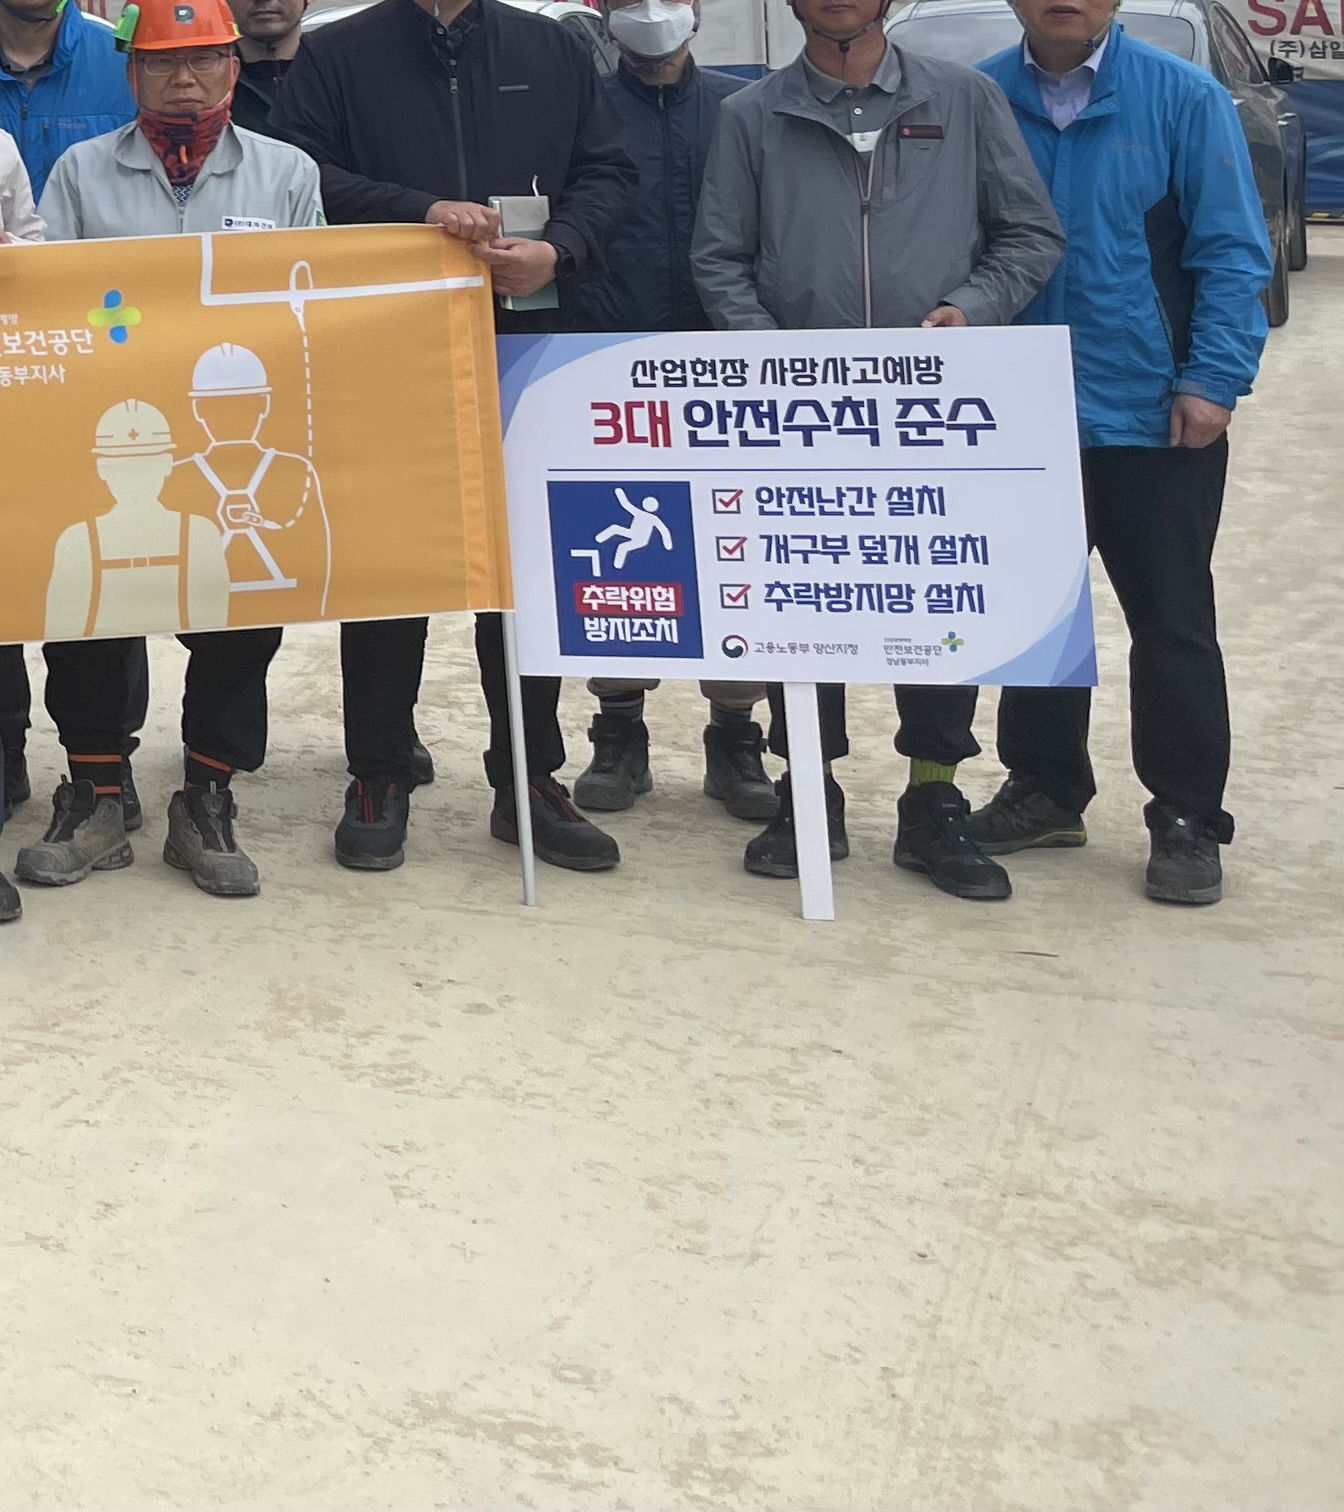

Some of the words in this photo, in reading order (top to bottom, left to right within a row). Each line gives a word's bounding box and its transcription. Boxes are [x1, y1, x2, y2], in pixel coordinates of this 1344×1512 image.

[630, 356, 748, 389] 산업현장
[759, 355, 944, 387] 사망사고예방
[590, 399, 672, 448] 3대
[682, 395, 881, 449] 안전수칙
[893, 396, 997, 448] 준수
[755, 485, 877, 518] 안전난간
[885, 484, 946, 517] 설치
[759, 534, 851, 566] 개구부
[858, 534, 921, 566] 덮개
[927, 533, 990, 566] 설치
[581, 584, 677, 613] 추락위험
[763, 582, 916, 615] 추락방지망
[923, 582, 986, 616] 설치
[583, 617, 679, 644] 방지조치
[754, 642, 810, 655] 고용노동부
[813, 642, 859, 656] 양산지청
